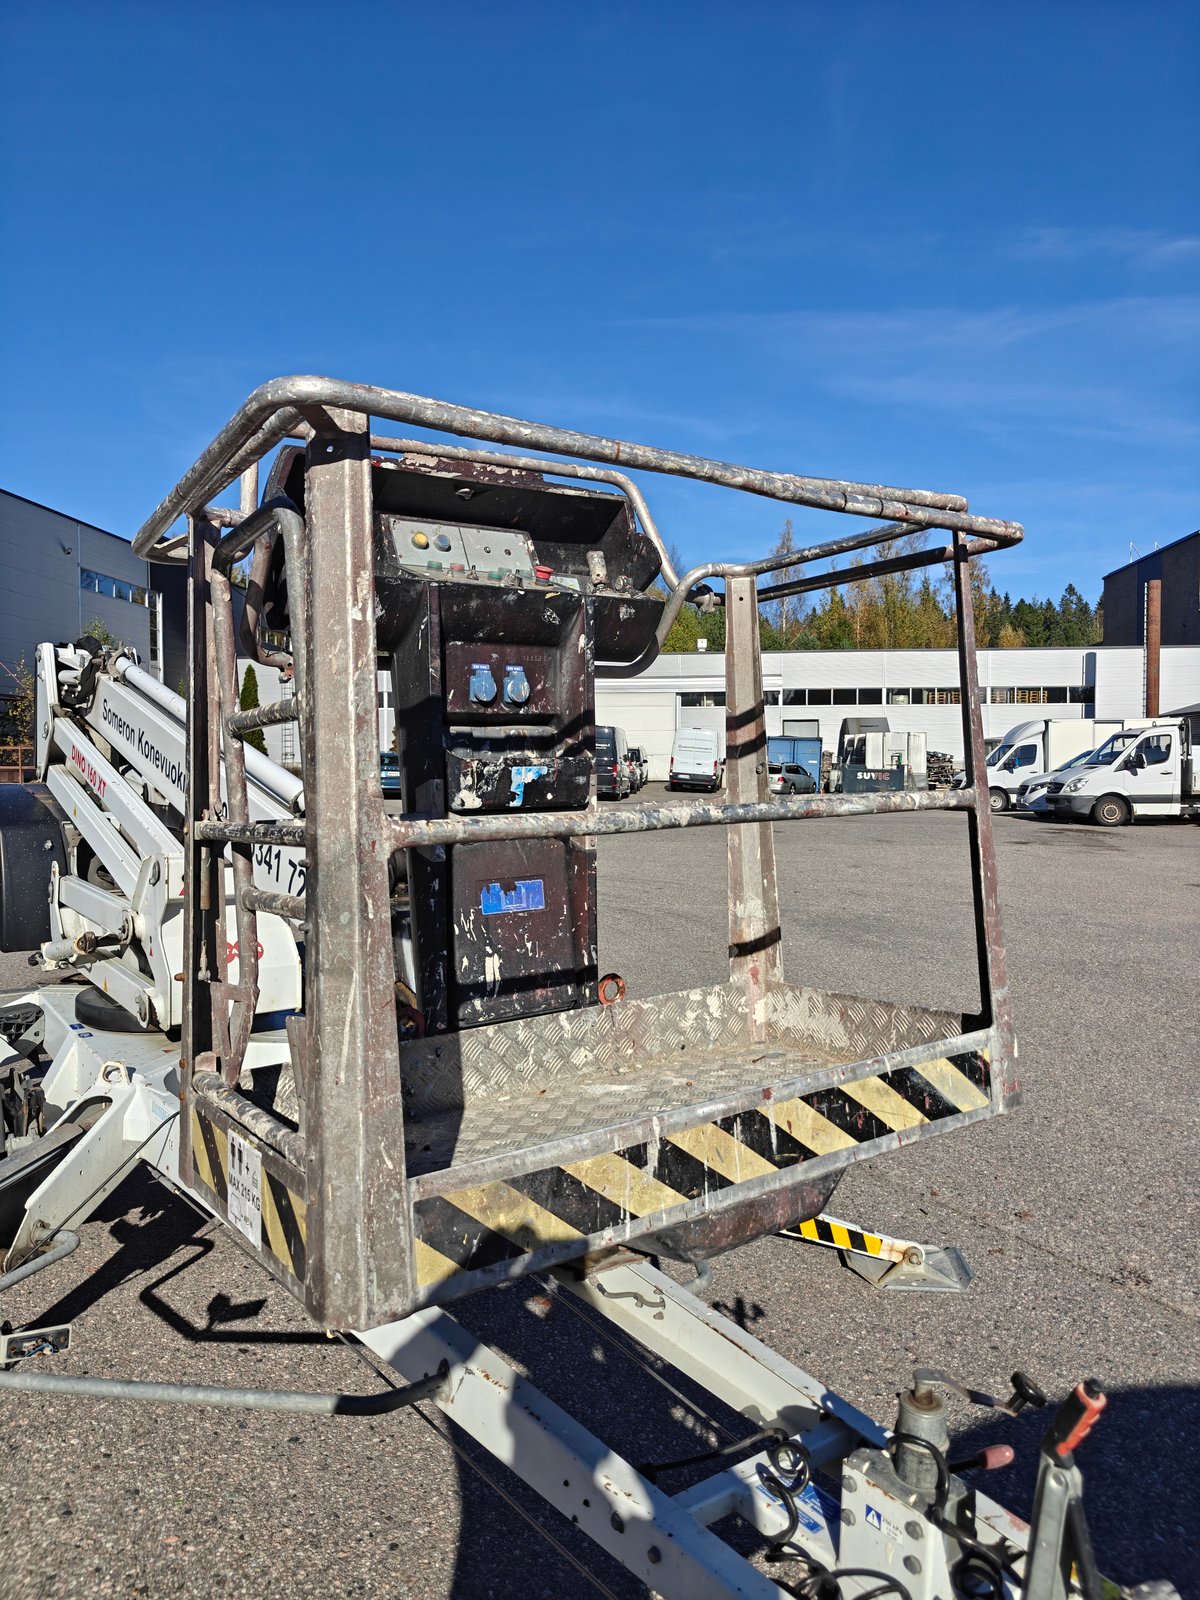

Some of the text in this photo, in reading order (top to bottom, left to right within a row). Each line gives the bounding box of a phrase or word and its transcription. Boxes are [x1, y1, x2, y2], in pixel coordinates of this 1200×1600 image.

[102, 698, 135, 747] Someron
[71, 744, 107, 798] DINO 160 XT
[856, 771, 890, 781] SUVIC
[252, 843, 281, 883] 341
[228, 1171, 261, 1212] MAX 215 KG
